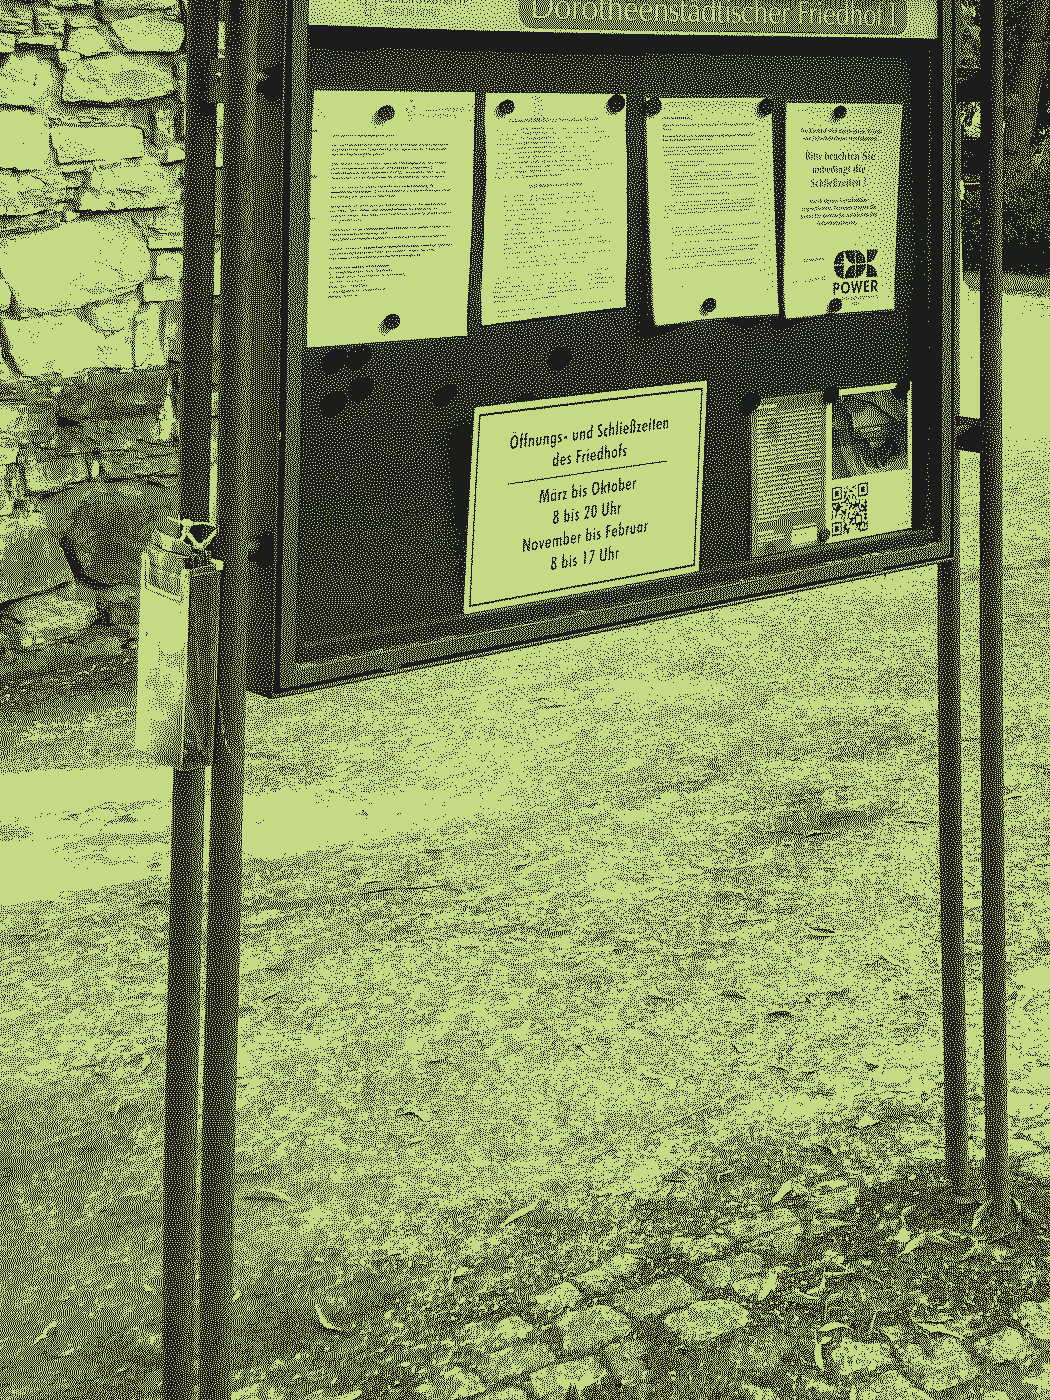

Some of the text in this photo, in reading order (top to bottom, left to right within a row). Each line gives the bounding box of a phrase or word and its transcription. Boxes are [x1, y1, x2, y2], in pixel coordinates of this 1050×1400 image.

[797, 0, 884, 27] Friedhof
[805, 150, 877, 161] Bitte beachten Sie
[812, 163, 866, 176] unbedingt die
[833, 279, 878, 296] POWER
[509, 417, 669, 449] Öffnungs- und Schließzeiten
[552, 443, 628, 466] des Friedhofs
[539, 478, 637, 503] März bis Oktober
[552, 500, 622, 524] 8 bis 20 Uhr
[522, 522, 649, 552] November bis Februar
[550, 546, 620, 571] 8 bis 17 Uhr
